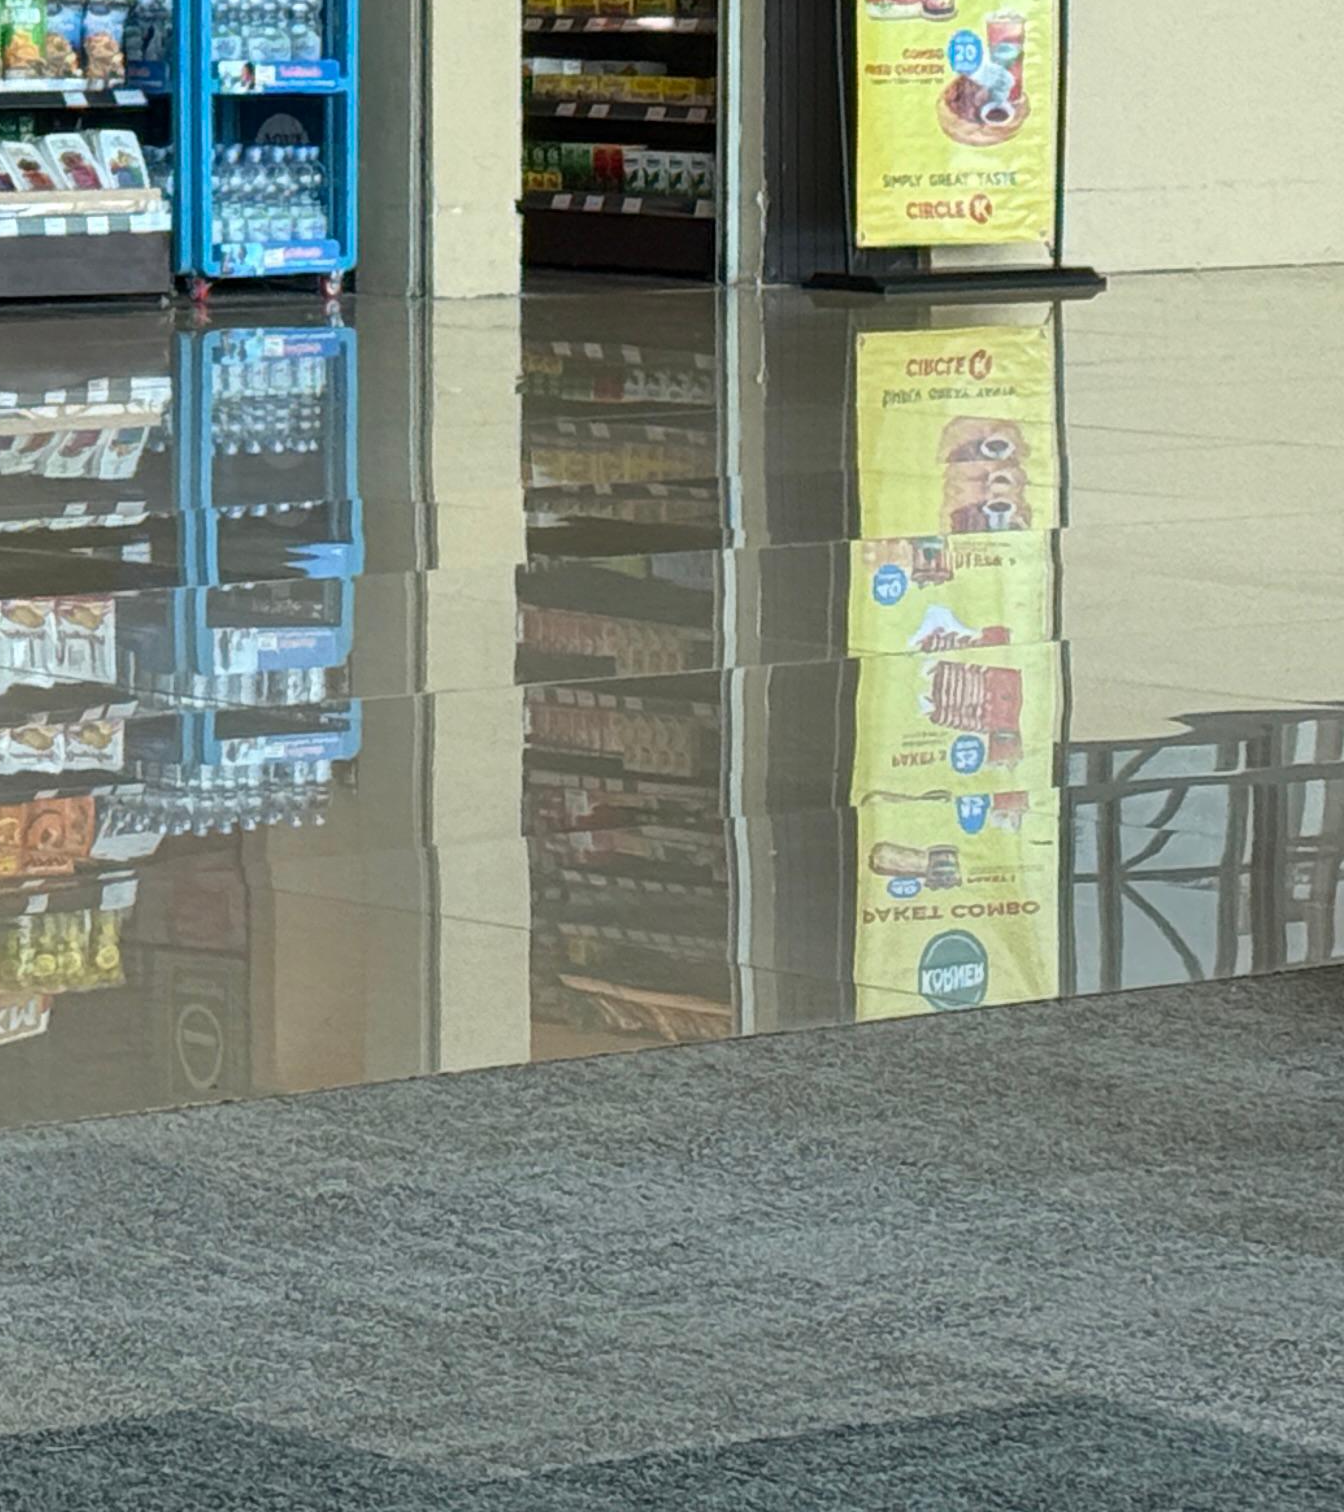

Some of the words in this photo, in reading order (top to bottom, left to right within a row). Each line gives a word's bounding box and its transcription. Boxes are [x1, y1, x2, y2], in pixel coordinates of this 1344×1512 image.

[882, 173, 923, 188] SIMPLY
[929, 172, 969, 187] GREAT
[976, 171, 1018, 187] TASTE
[906, 200, 966, 220] CIRCLE
